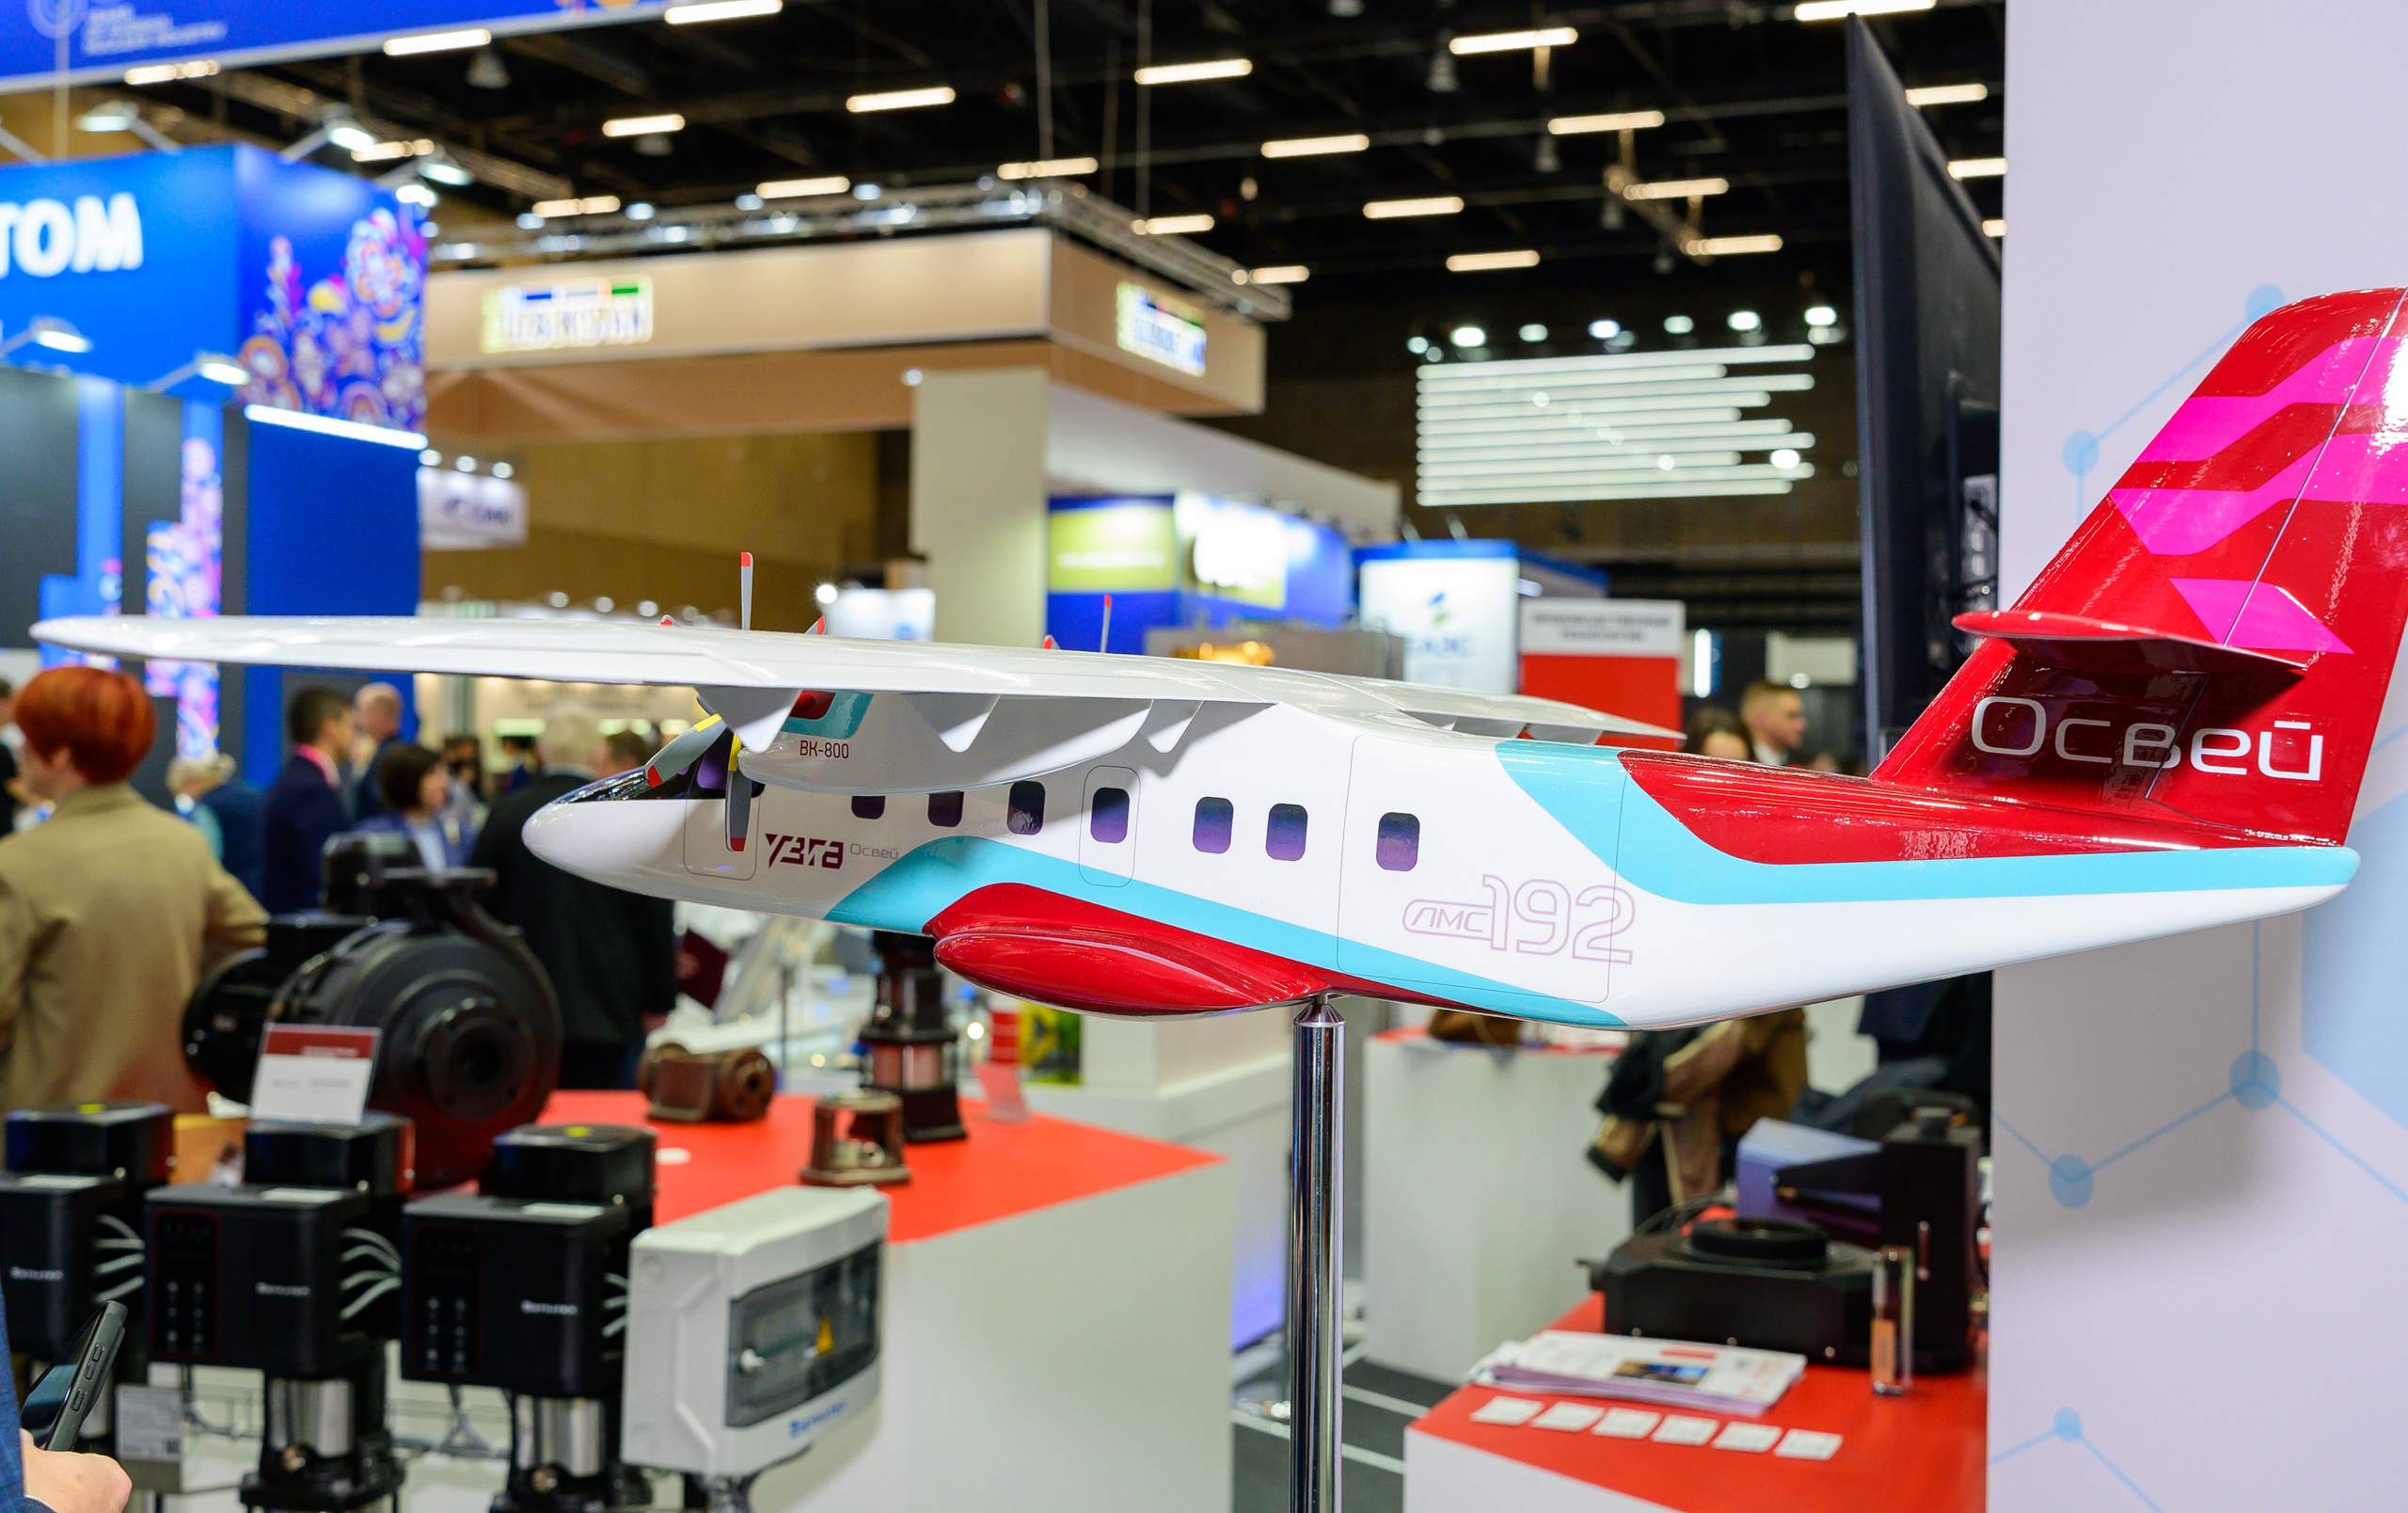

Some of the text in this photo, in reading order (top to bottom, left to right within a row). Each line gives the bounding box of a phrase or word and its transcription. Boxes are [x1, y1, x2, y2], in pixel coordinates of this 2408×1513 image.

[1972, 695, 2323, 781] Освей
[800, 740, 849, 758] ВК-800
[849, 843, 899, 860] Освей
